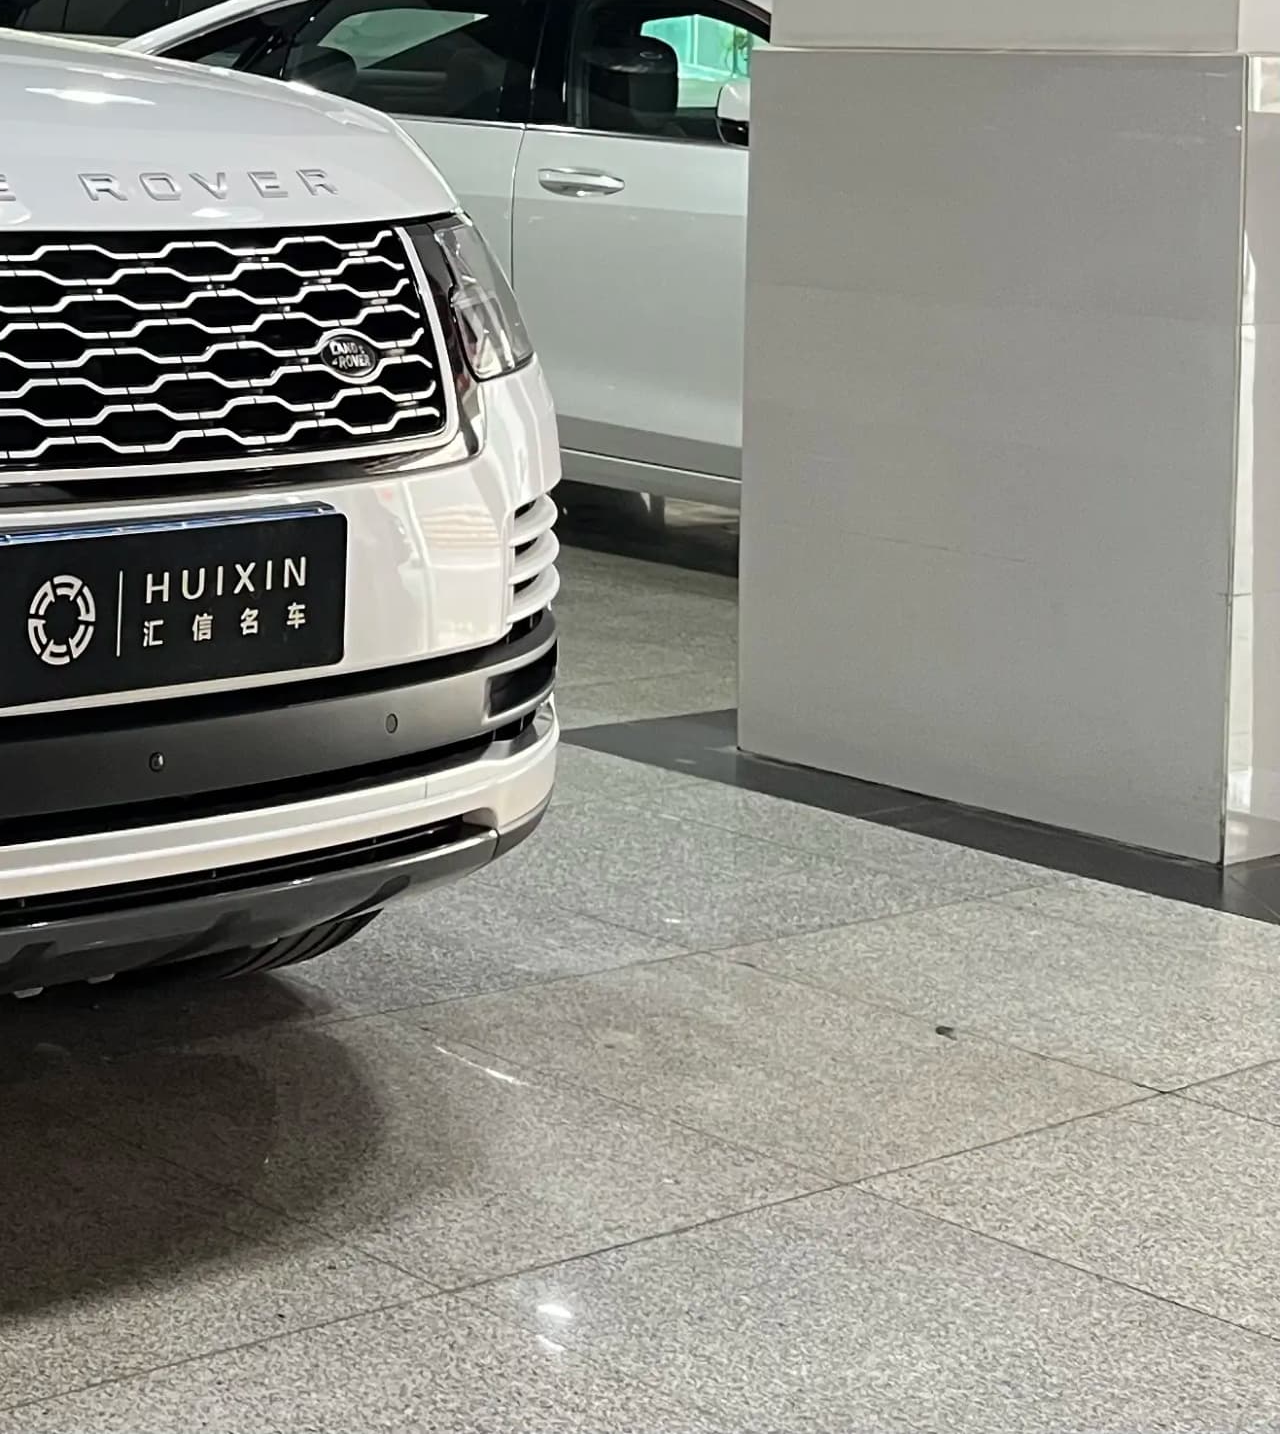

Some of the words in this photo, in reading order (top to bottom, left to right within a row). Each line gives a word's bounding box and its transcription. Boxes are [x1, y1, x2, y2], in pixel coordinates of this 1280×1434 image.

[77, 168, 339, 202] ROVER
[339, 354, 371, 370] ROVER
[145, 556, 307, 604] HUIXIN
[142, 601, 307, 648] 汇信名车
